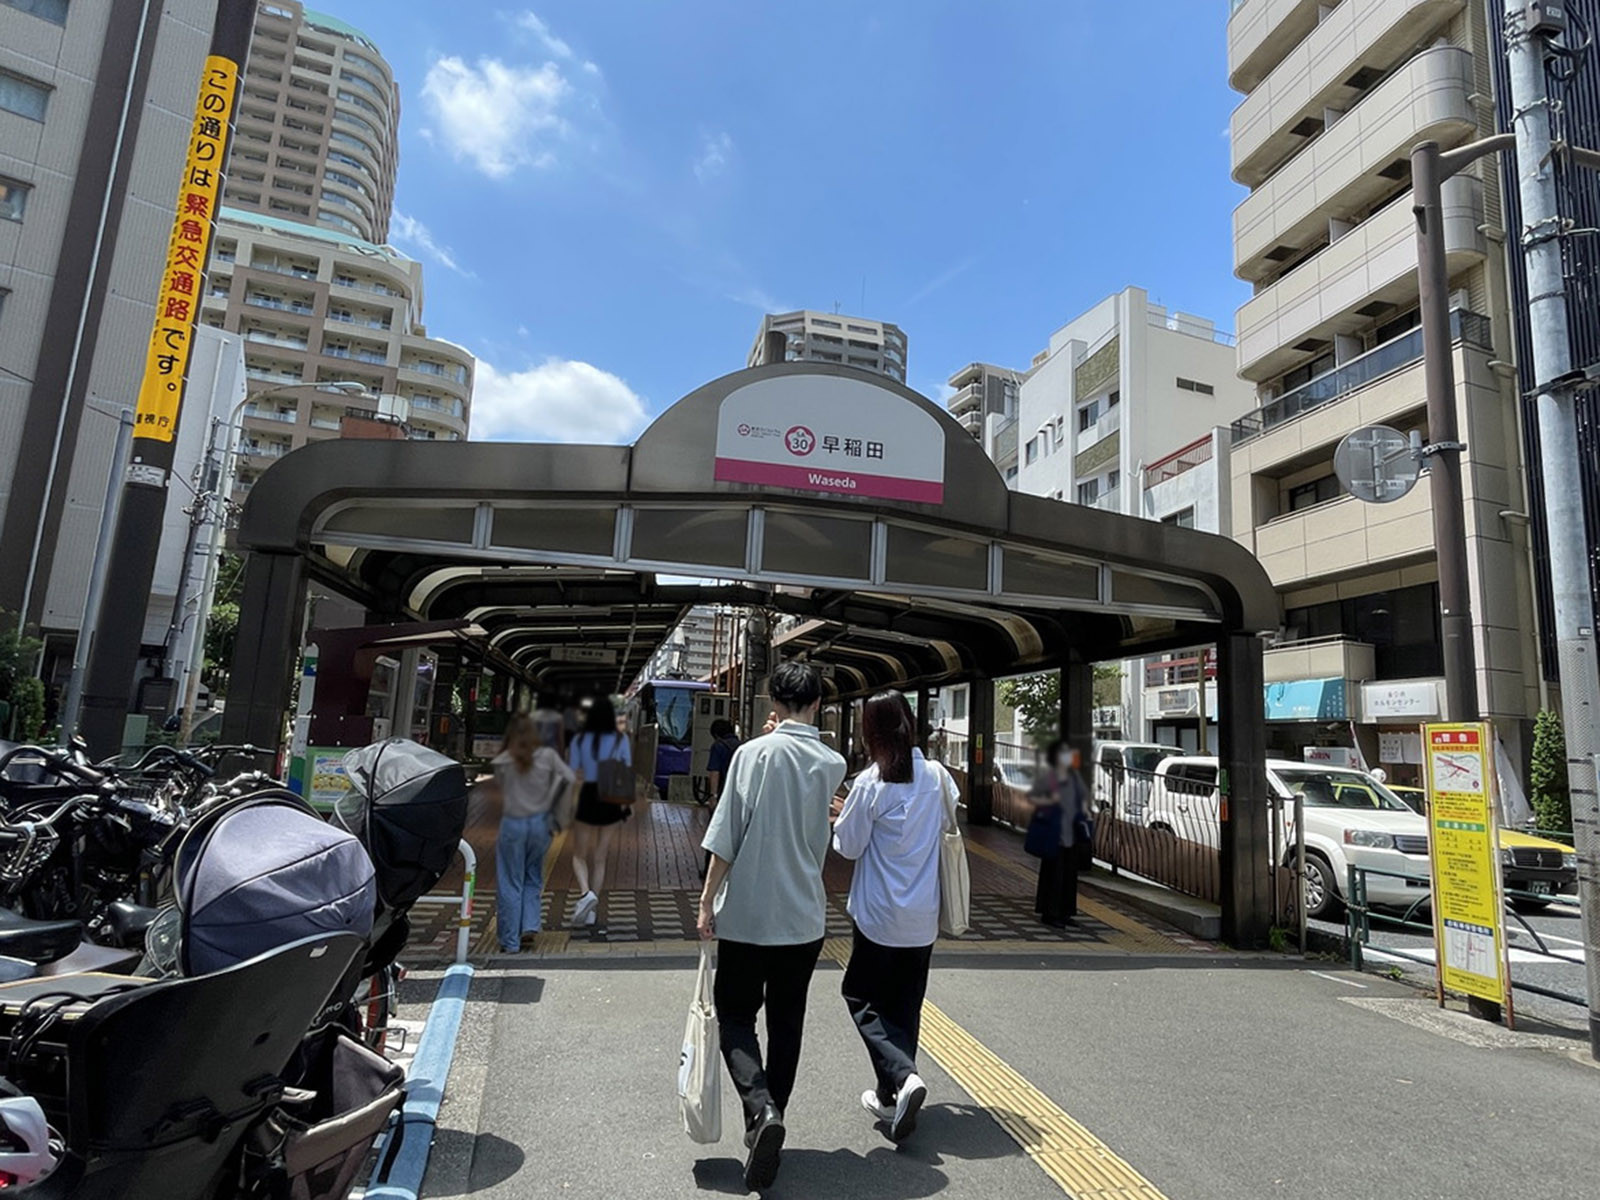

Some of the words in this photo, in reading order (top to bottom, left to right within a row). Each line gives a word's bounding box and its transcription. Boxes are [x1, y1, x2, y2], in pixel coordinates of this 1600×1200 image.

[157, 69, 229, 391] この通りは緊急交通路です。
[792, 438, 808, 450] 30
[822, 436, 883, 459] 早稲田
[808, 472, 857, 489] Waseda
